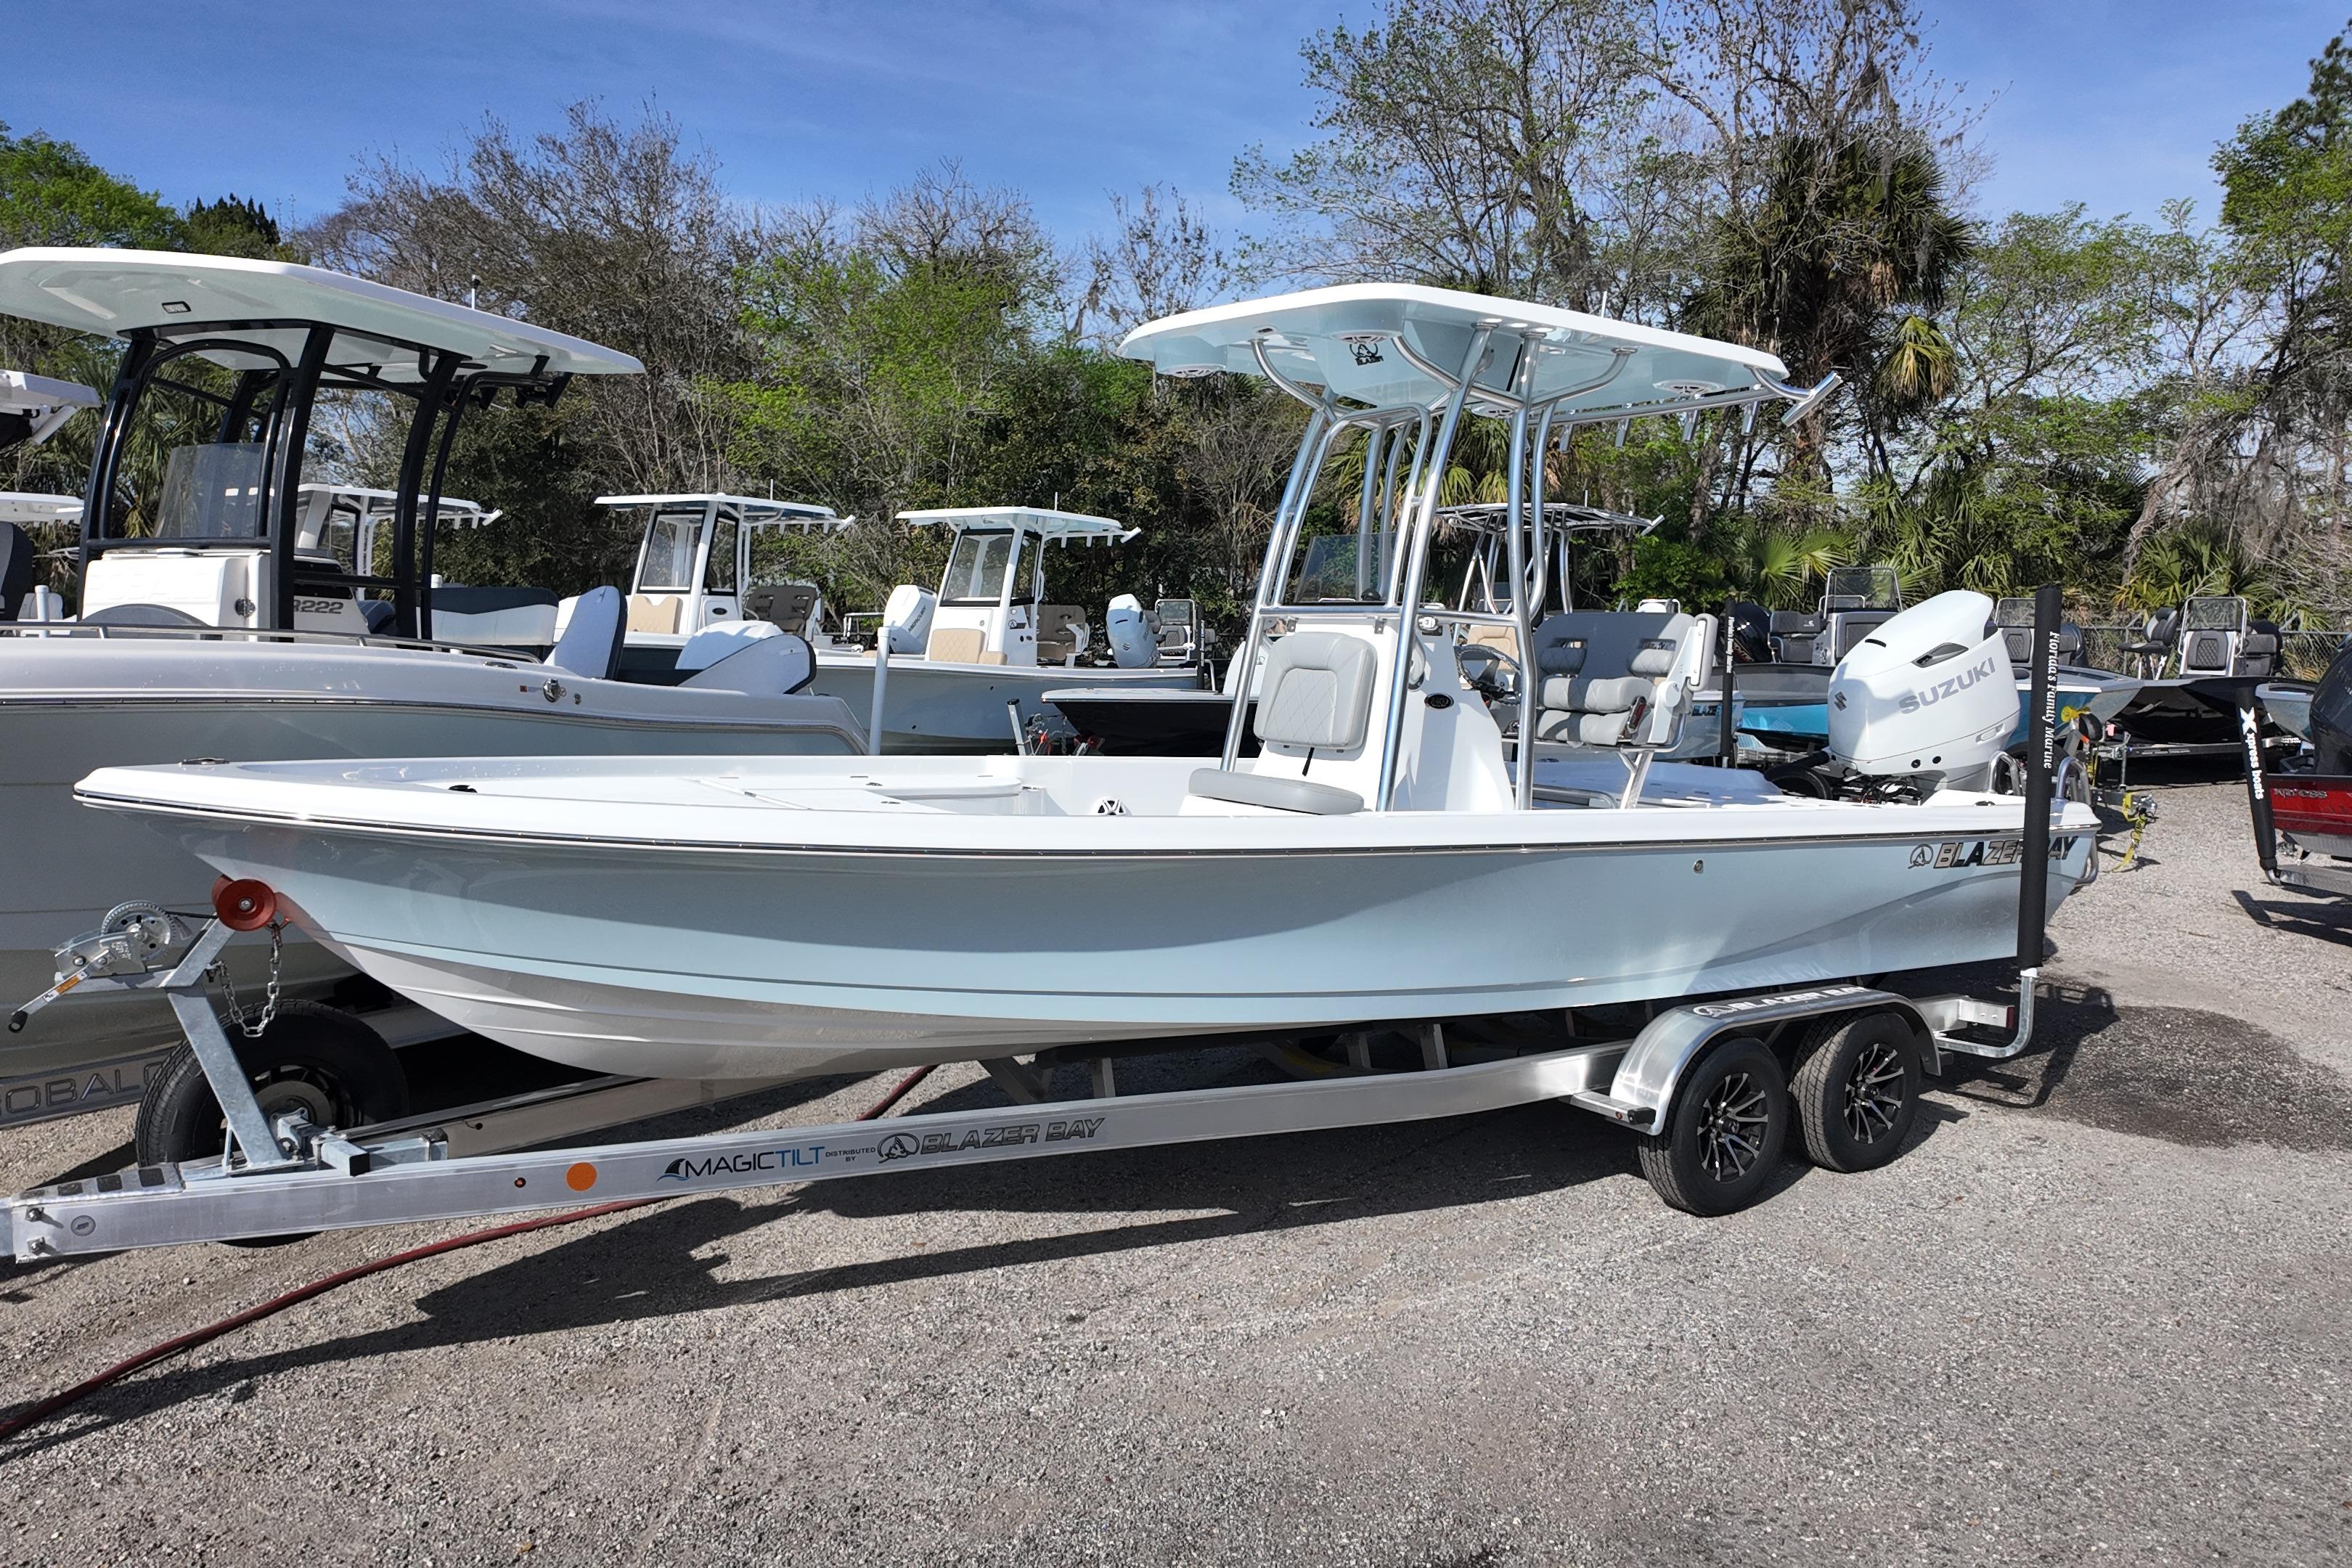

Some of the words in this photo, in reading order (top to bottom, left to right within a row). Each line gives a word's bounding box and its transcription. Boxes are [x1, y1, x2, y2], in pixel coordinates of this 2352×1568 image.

[2047, 631, 2061, 682] Florida's
[1898, 656, 1996, 714] SUZUKI
[2041, 684, 2057, 724] Family
[2043, 726, 2055, 769] Marine
[2245, 732, 2260, 769] xpress
[2252, 769, 2265, 800] boats
[2047, 836, 2078, 861] AY
[1728, 992, 1829, 1011] BLAZER
[1824, 985, 1873, 997] BAY
[0, 1062, 163, 1113] OBAL
[920, 1124, 1040, 1155] BLAZER
[1045, 1117, 1106, 1143] BAY
[685, 1146, 825, 1177] MAGICTILT
[825, 1147, 876, 1158] DISTRIBUTED
